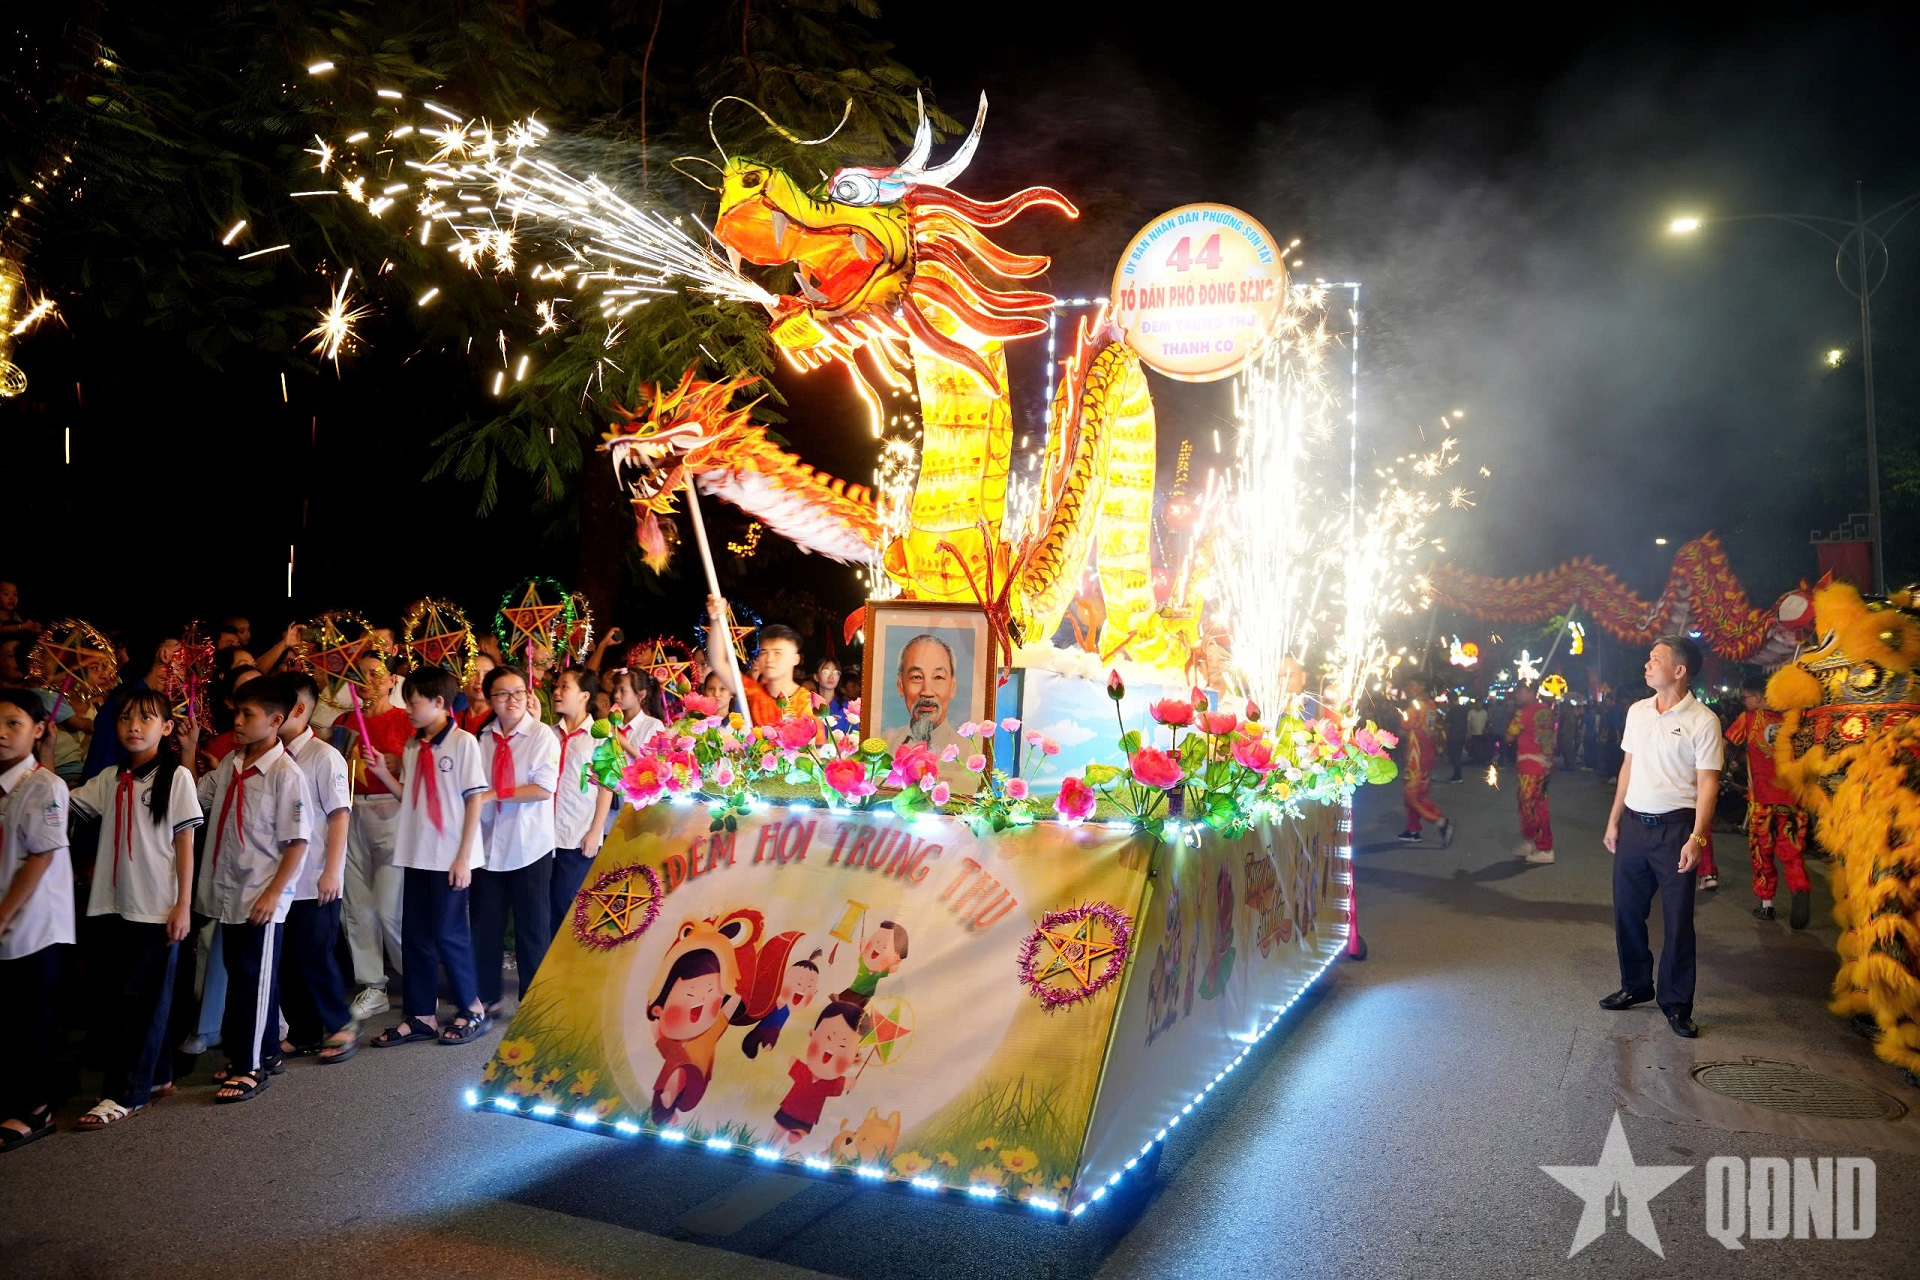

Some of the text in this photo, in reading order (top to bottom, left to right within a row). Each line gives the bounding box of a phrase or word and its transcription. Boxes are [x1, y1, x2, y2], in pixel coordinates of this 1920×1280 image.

[1178, 211, 1200, 226] DÂN
[1242, 226, 1263, 247] SƠN
[1165, 233, 1225, 272] 44
[664, 829, 738, 893] ĐÊM
[829, 822, 943, 883] TRUNG
[942, 857, 1018, 927] THU
